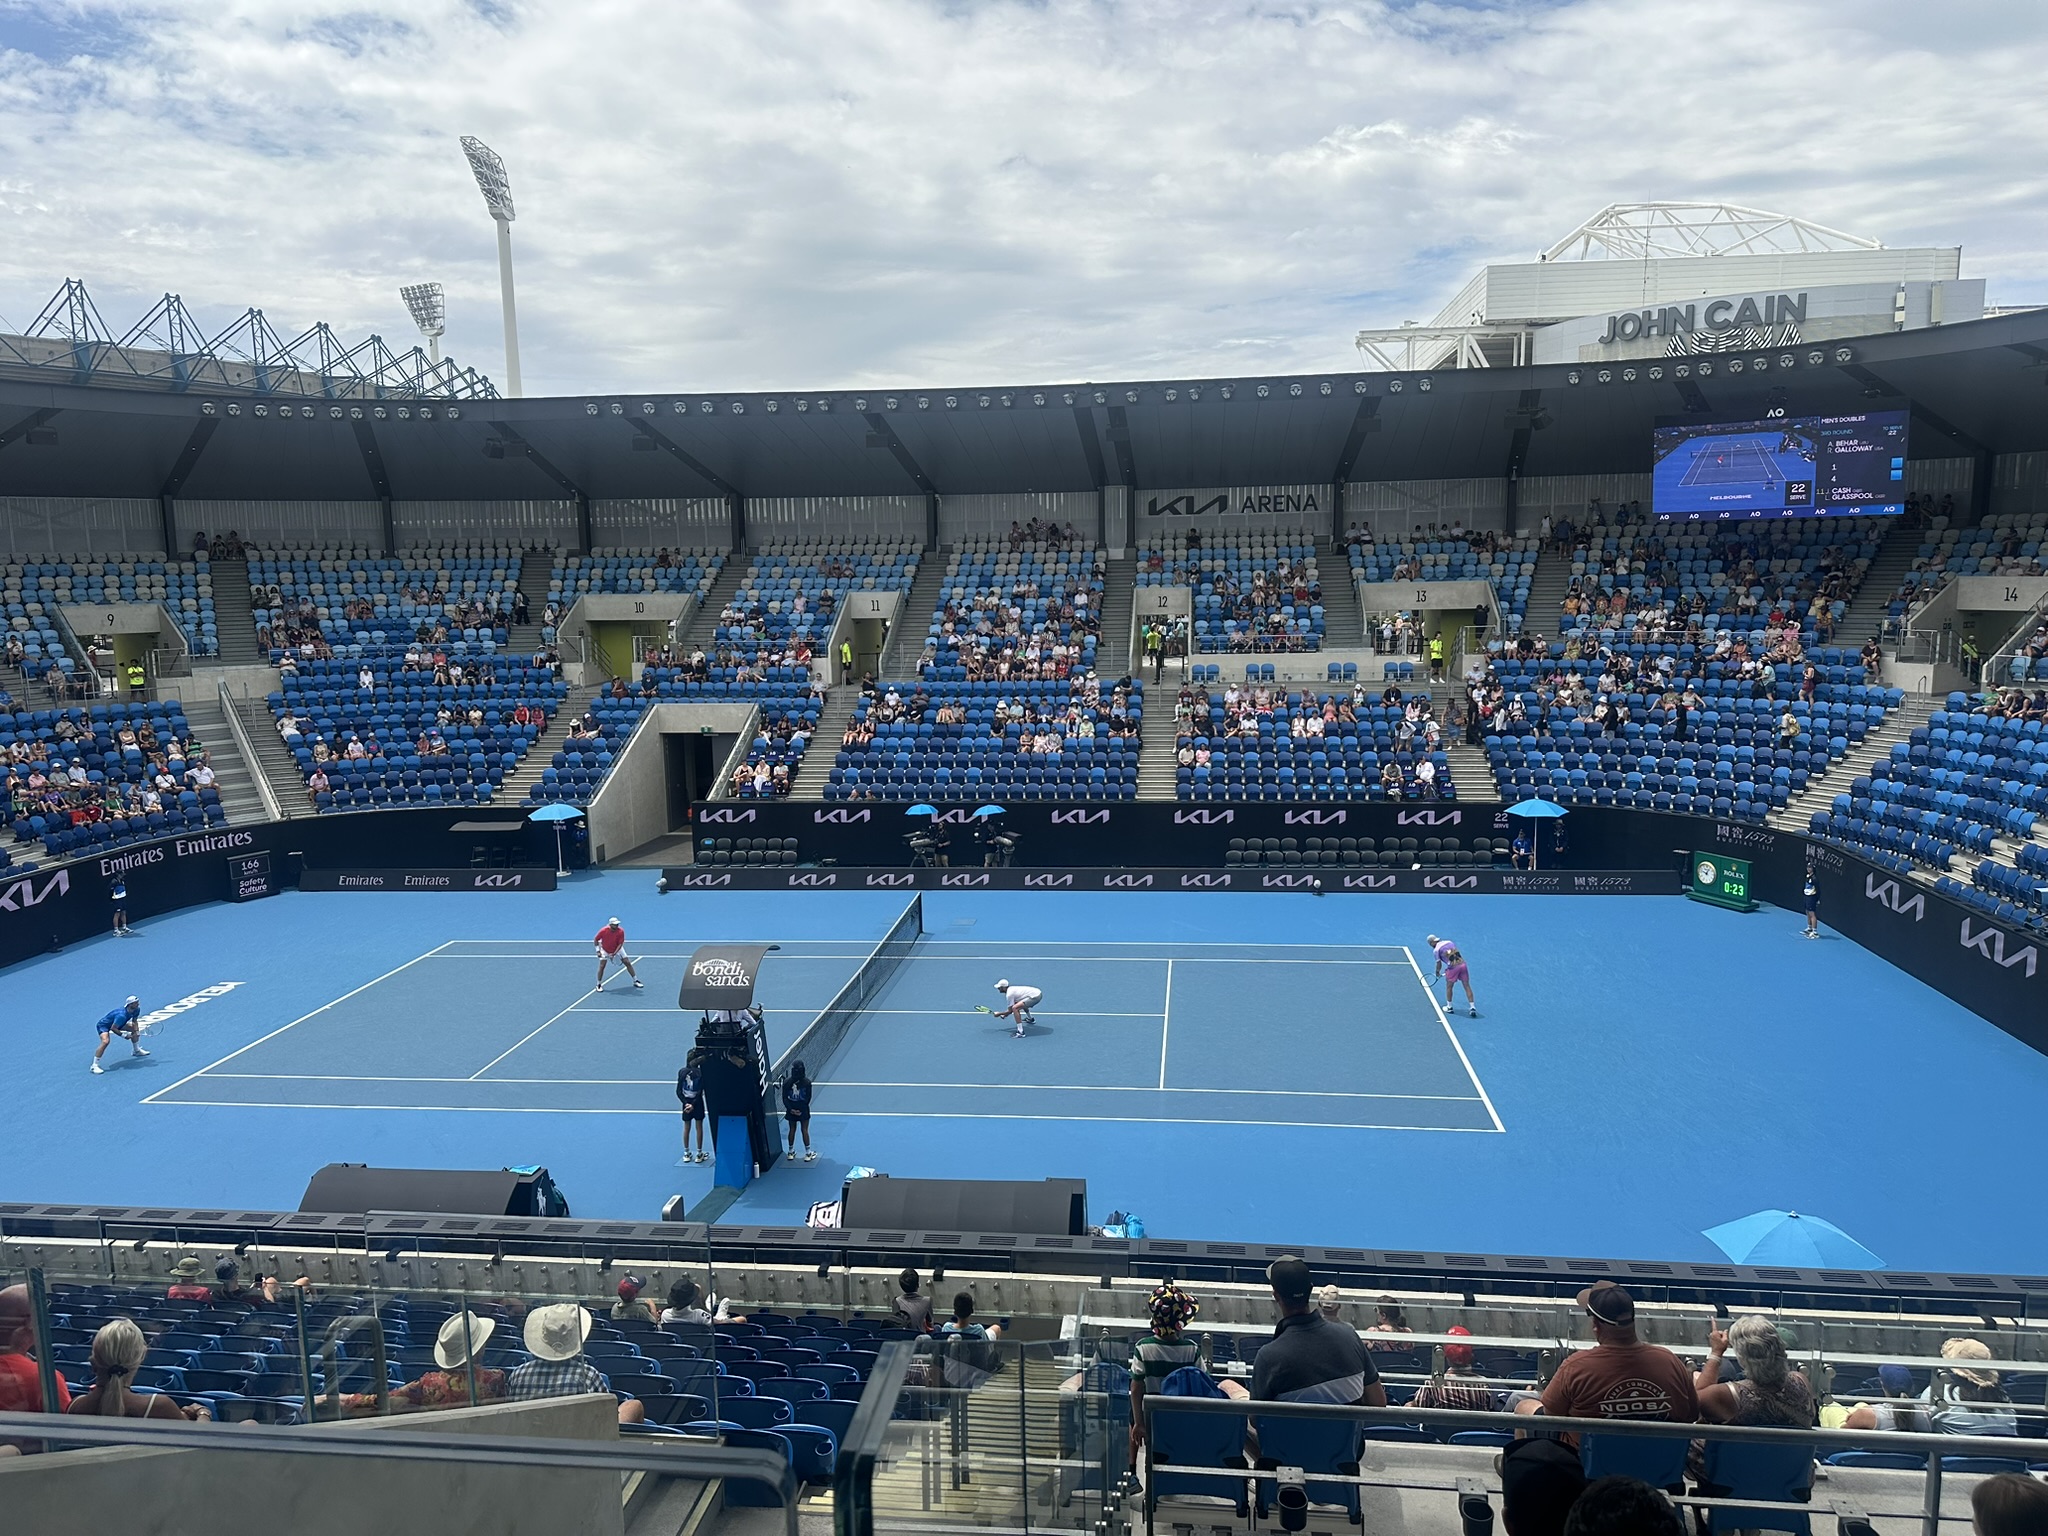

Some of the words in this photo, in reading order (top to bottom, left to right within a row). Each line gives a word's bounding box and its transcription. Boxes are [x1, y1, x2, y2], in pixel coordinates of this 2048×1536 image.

[1598, 303, 1695, 344] JOHN
[1704, 292, 1808, 331] CAIN
[1664, 323, 1803, 358] ARENA
[1767, 407, 1785, 418] AO
[1839, 415, 1866, 423] DOUBLES
[1835, 439, 1859, 447] BEHAR
[1834, 445, 1874, 454] GALLOWAY
[1791, 484, 1806, 493] 22
[1832, 492, 1874, 500] GLASSPOOL
[1241, 493, 1319, 513] ARENA
[1416, 590, 1427, 602] 13
[2004, 587, 2018, 602] 14
[634, 602, 645, 613] 10
[871, 600, 880, 611] 11
[1157, 595, 1168, 608] 12
[107, 613, 115, 626] 9
[1494, 812, 1508, 822] 22
[1744, 831, 1775, 844] 1573
[175, 831, 253, 857] Emirates
[100, 847, 164, 876] Emirates
[241, 859, 260, 870] 166
[338, 874, 384, 888] Emirates
[404, 874, 450, 888] Emirates
[1528, 876, 1559, 886] 1573
[1723, 870, 1745, 880] ROLEX
[239, 877, 266, 888] Safety
[1600, 877, 1632, 886] 1573
[239, 884, 267, 895] Culture
[1723, 881, 1744, 896] 0:23
[692, 960, 742, 976] bondi
[704, 969, 750, 987] sands
[108, 981, 247, 1035] MELBOUR
[753, 1029, 769, 1097] Haier
[1626, 1381, 1660, 1396] COMPANY
[1600, 1401, 1672, 1412] NOOSA
